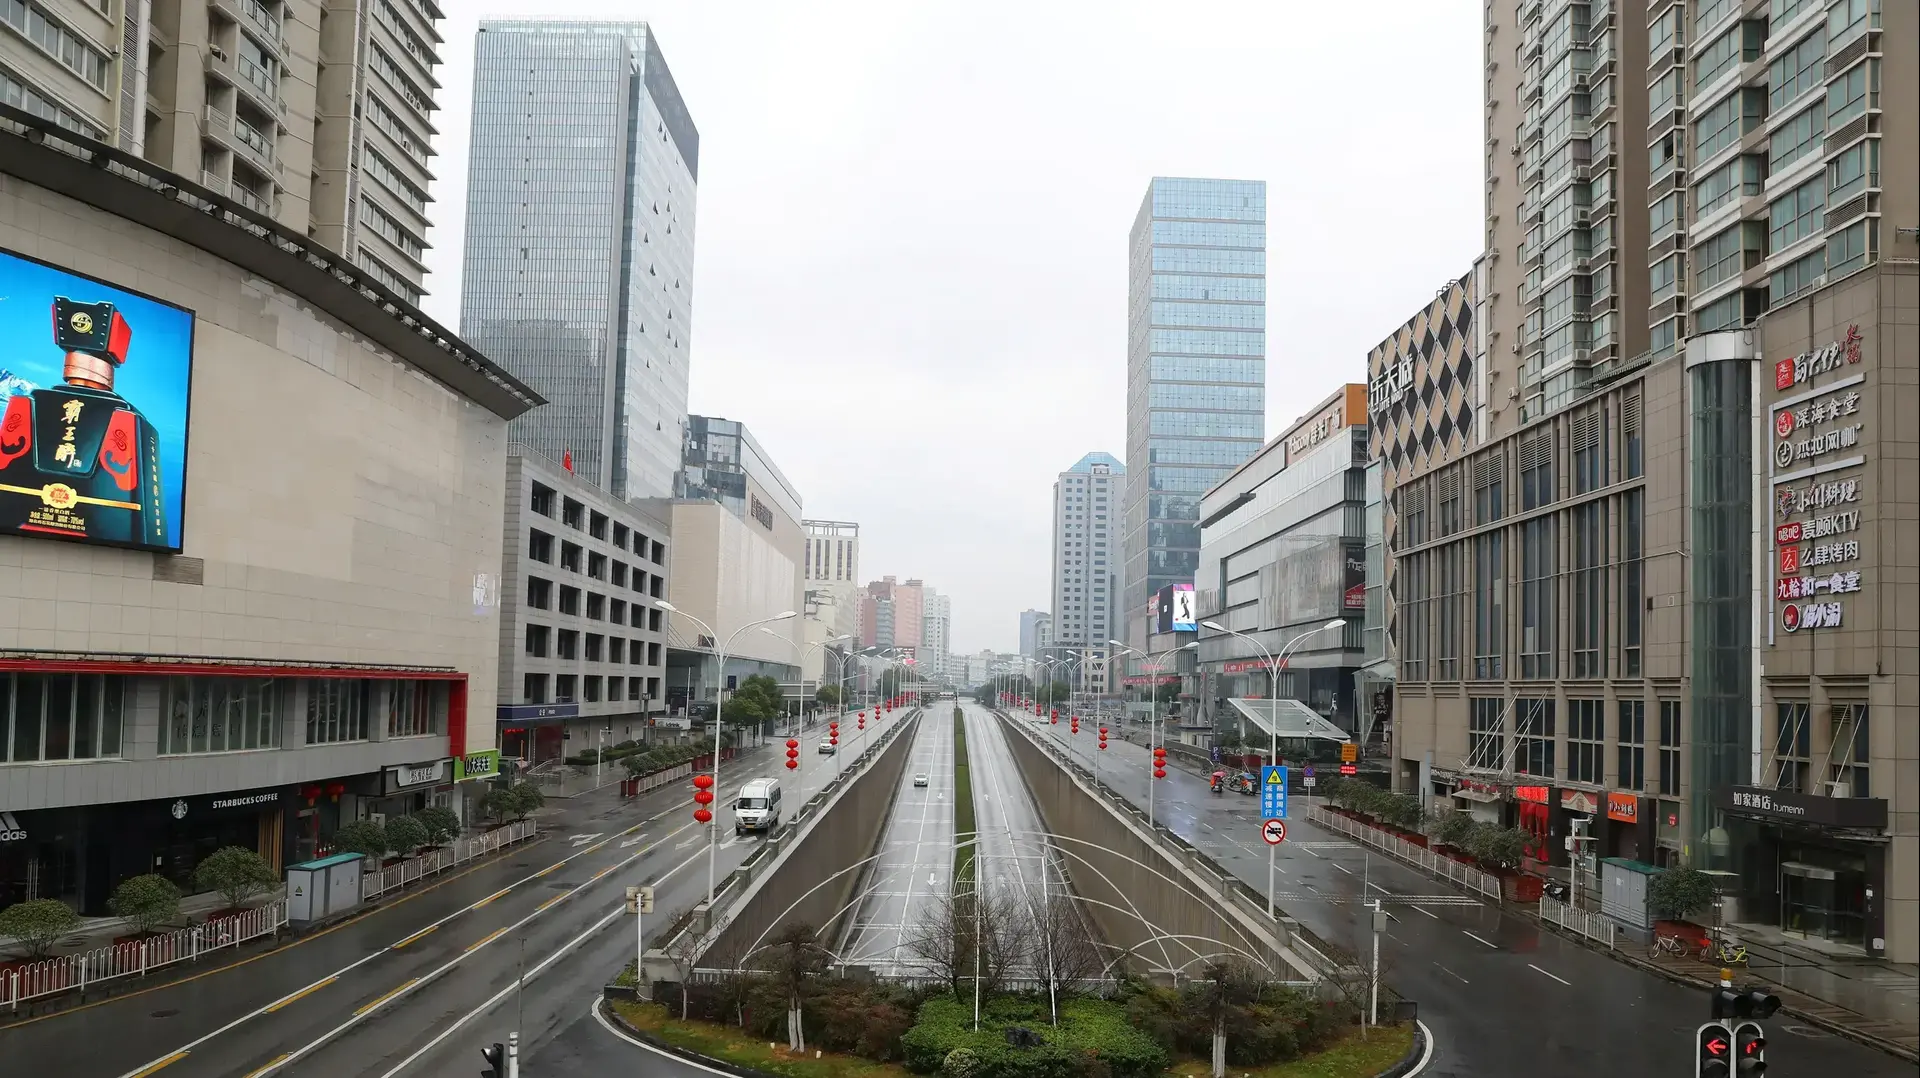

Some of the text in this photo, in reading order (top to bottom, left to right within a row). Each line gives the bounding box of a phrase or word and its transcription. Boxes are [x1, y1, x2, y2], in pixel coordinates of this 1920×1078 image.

[1370, 353, 1413, 407] 乐天城
[1796, 392, 1860, 428] 深海食堂
[54, 399, 84, 468] 霸王醉
[1796, 426, 1858, 459] 杰拉网咖
[1796, 481, 1856, 512] 小川料理
[1778, 526, 1799, 542] 唱吧
[1801, 540, 1858, 567] 么肆烤肉
[212, 792, 279, 809] STARBUCKS COFFEE
[1265, 785, 1273, 817] 减速慢行
[1733, 792, 1771, 810] 如家酒店
